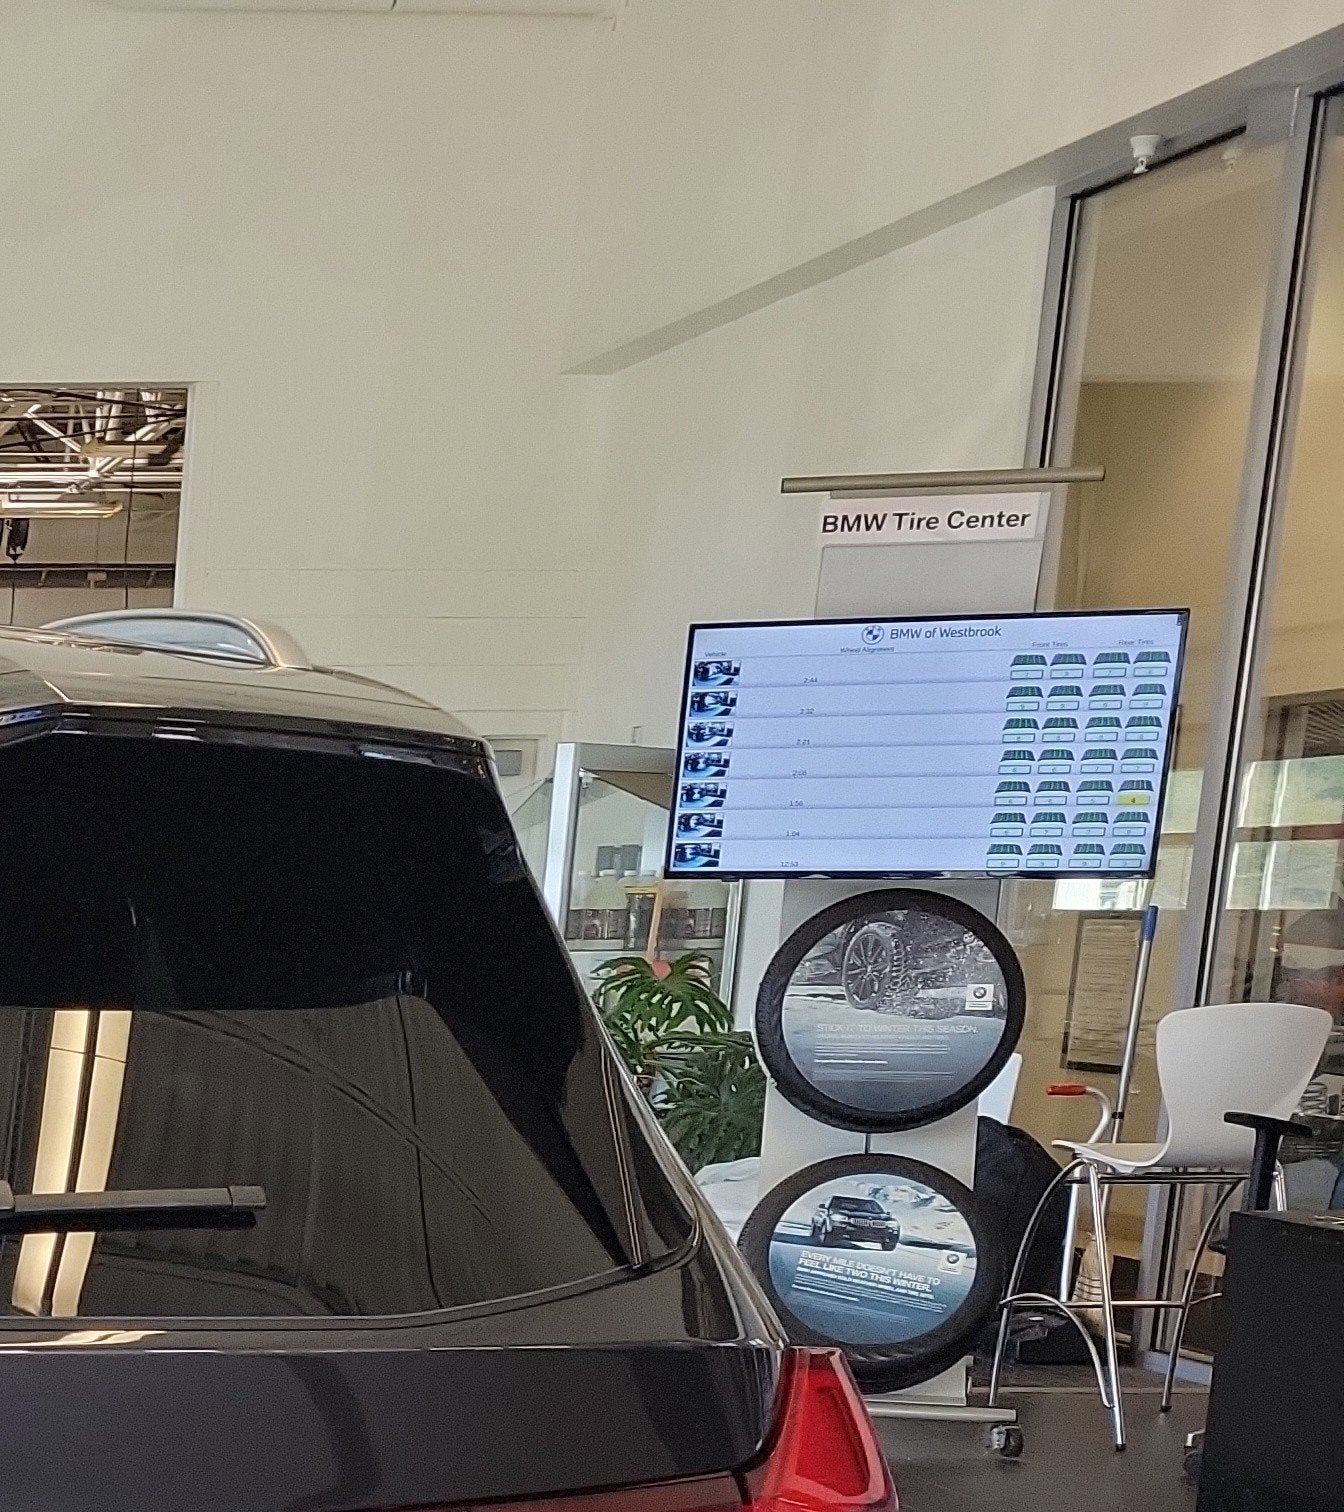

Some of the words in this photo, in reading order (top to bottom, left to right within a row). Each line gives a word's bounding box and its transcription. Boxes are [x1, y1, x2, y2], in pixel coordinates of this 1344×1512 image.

[822, 513, 888, 533] BMW
[893, 512, 940, 531] Tire
[947, 510, 1031, 530] Center
[890, 628, 921, 639] BMW
[924, 627, 938, 638] of
[940, 626, 1002, 638] Westbrook
[798, 1258, 822, 1270] FEEL
[822, 1263, 845, 1274] LIKE
[846, 1267, 867, 1279] TWO
[870, 1273, 891, 1284] THIS
[801, 1250, 831, 1263] EVERY
[833, 1256, 856, 1267] MILE
[899, 1270, 926, 1282] HAVE
[928, 1276, 941, 1286] TO
